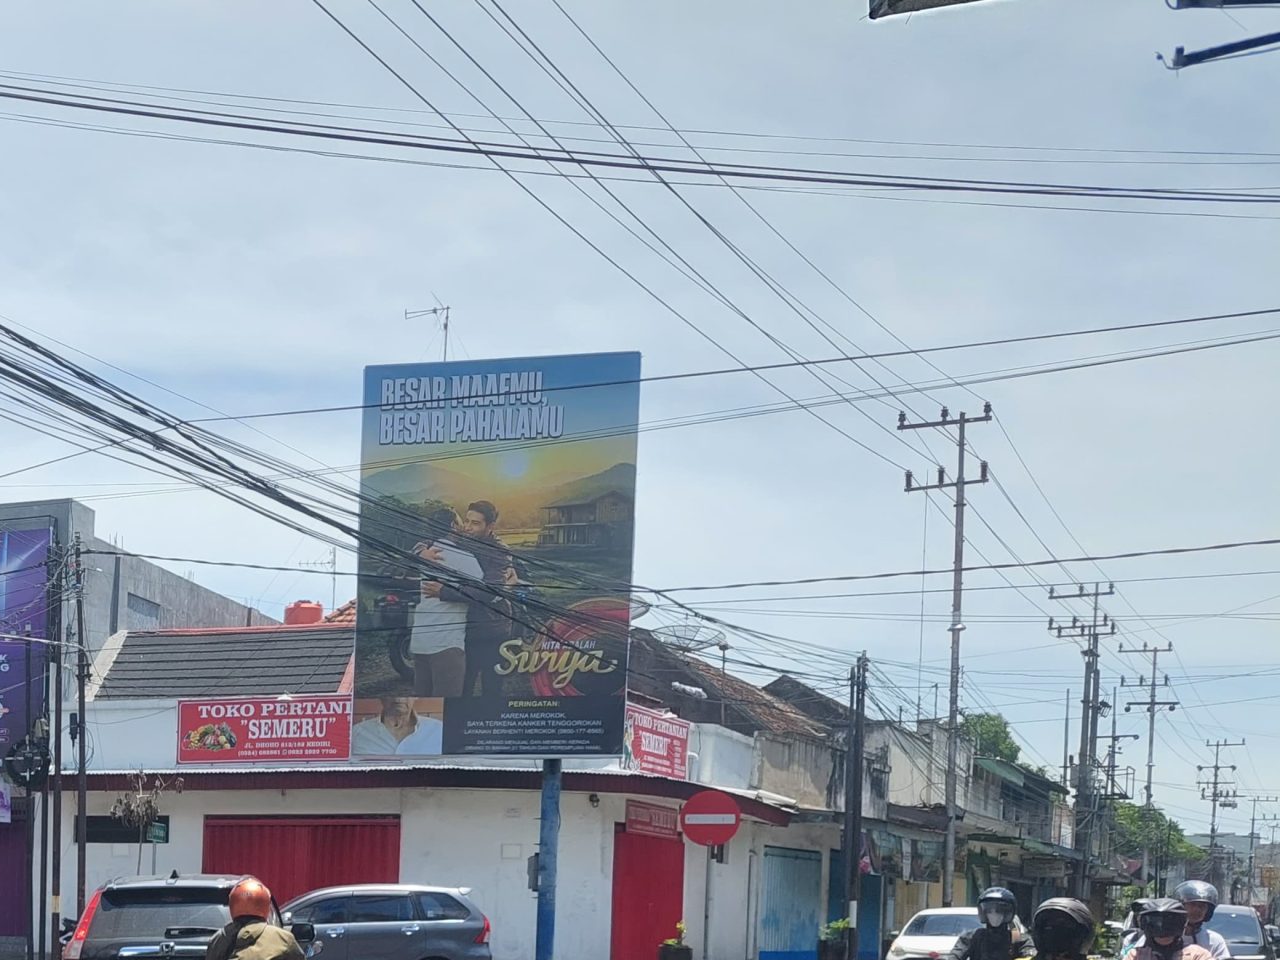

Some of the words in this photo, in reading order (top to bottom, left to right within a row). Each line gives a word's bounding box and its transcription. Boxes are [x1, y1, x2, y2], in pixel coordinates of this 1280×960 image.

[380, 376, 446, 411] BESAR
[379, 411, 446, 445] BESAR
[449, 405, 565, 443] PAHALAMU
[494, 639, 618, 688] Surya
[198, 703, 256, 719] TOKO
